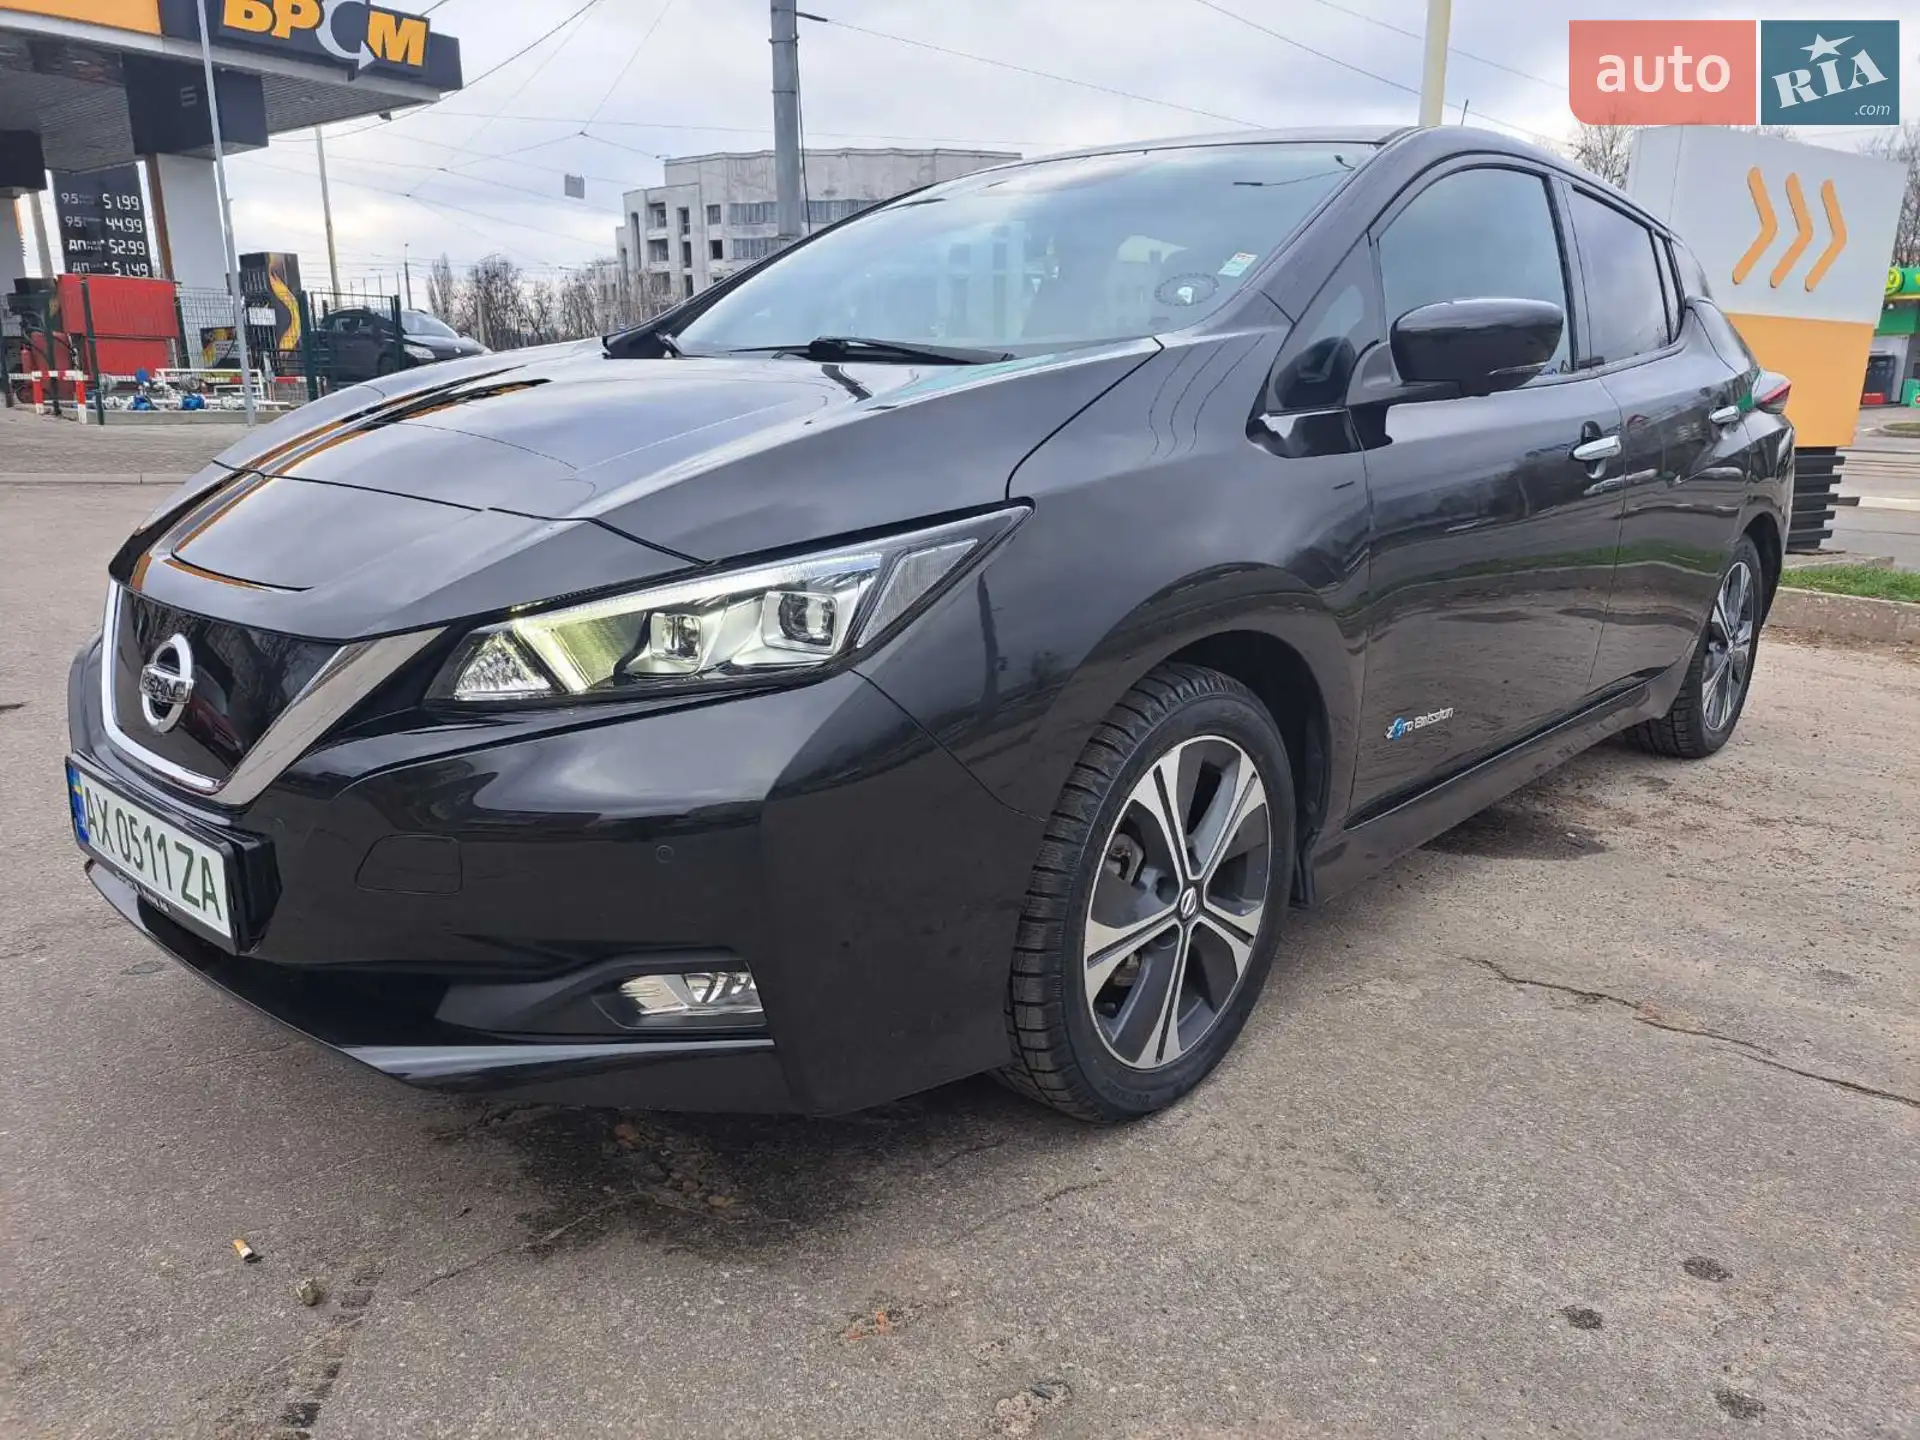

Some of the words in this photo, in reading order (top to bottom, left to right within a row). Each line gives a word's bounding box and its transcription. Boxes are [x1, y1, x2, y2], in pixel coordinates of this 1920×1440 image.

[61, 192, 79, 205] 95
[102, 193, 139, 210] 51.99
[65, 215, 82, 228] 95
[105, 216, 143, 233] 44.99
[108, 238, 146, 255] 52.99
[84, 786, 115, 854] AX
[115, 807, 173, 892] 0511
[174, 840, 222, 922] ZA
